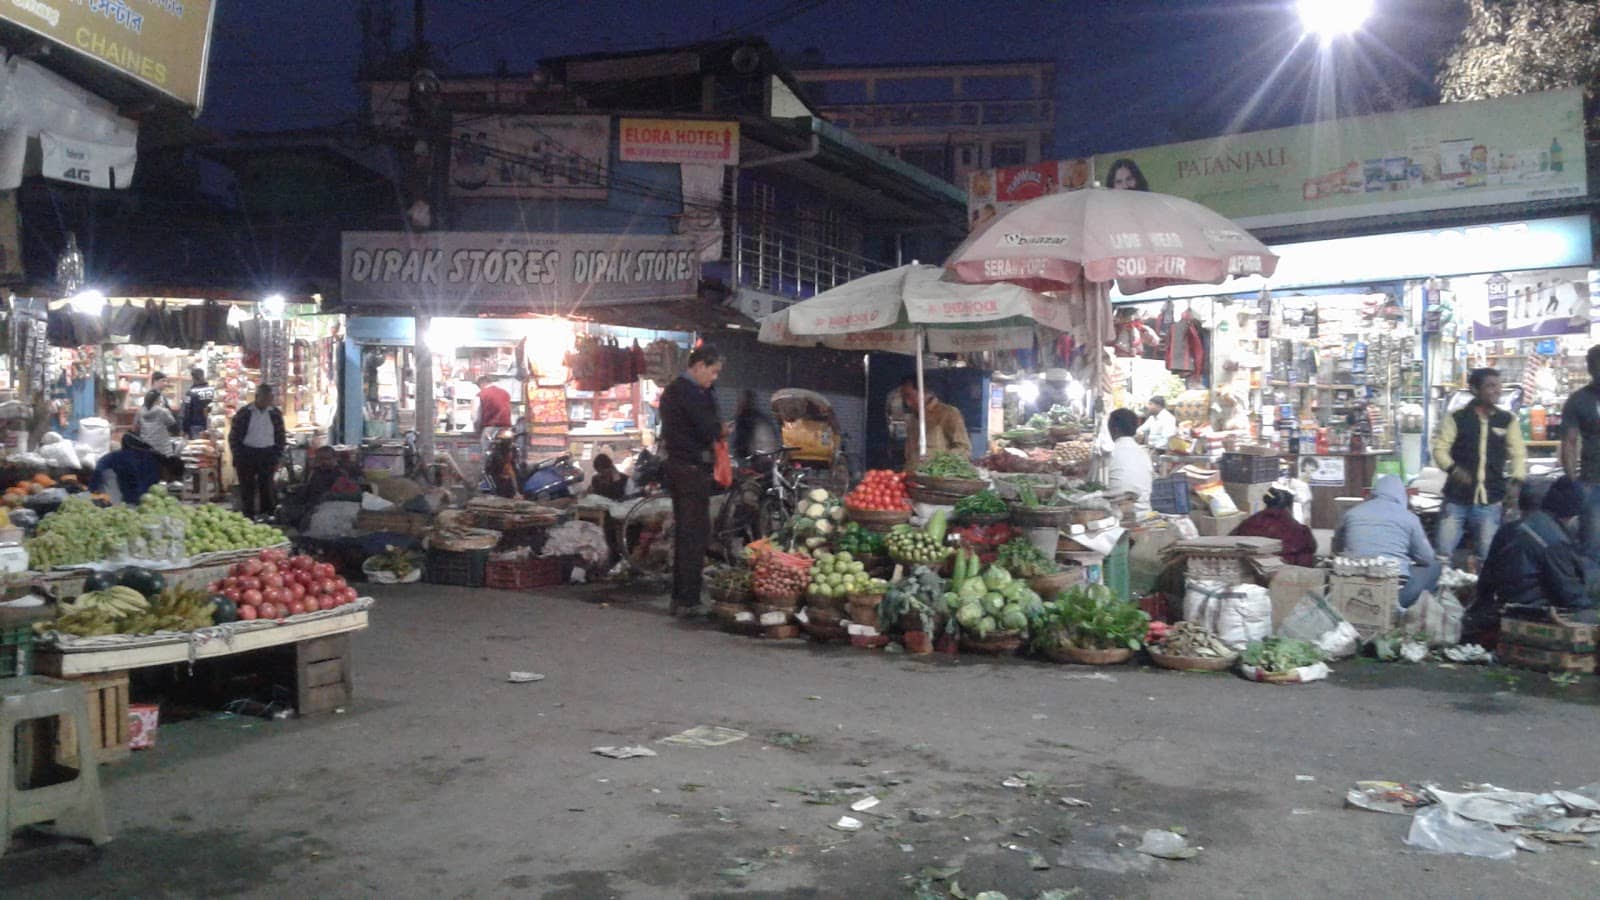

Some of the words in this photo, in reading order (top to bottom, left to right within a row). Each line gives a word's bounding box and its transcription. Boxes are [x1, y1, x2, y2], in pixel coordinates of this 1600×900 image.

[75, 26, 168, 84] CHAINES
[624, 127, 672, 143] ELORA
[675, 129, 721, 146] HOTEL
[62, 166, 91, 183] 4G
[1176, 145, 1288, 179] PATANJALI
[350, 248, 443, 285] DIPAK
[449, 248, 561, 286] STORES
[573, 250, 631, 284] DIPAK
[633, 249, 696, 283] STORES
